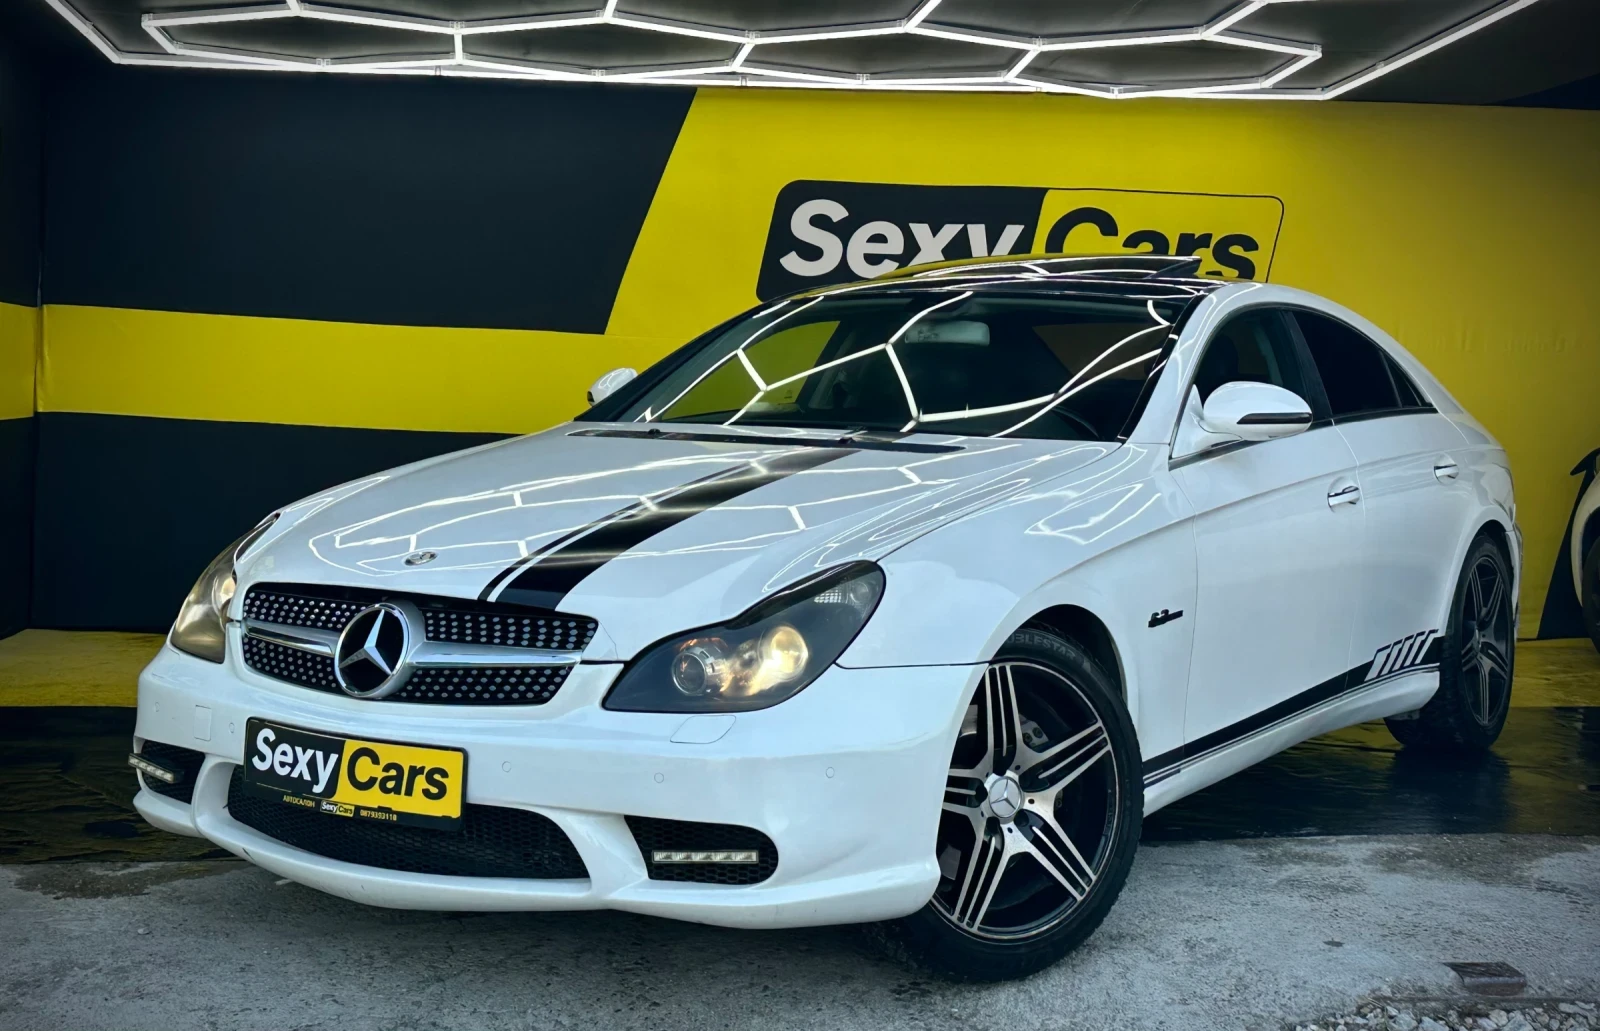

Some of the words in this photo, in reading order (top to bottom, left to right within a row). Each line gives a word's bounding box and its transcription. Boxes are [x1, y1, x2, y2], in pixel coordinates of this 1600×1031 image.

[252, 728, 338, 794] Sexy
[347, 747, 449, 801] Cars
[321, 801, 337, 813] Sexy
[338, 805, 353, 815] Cars
